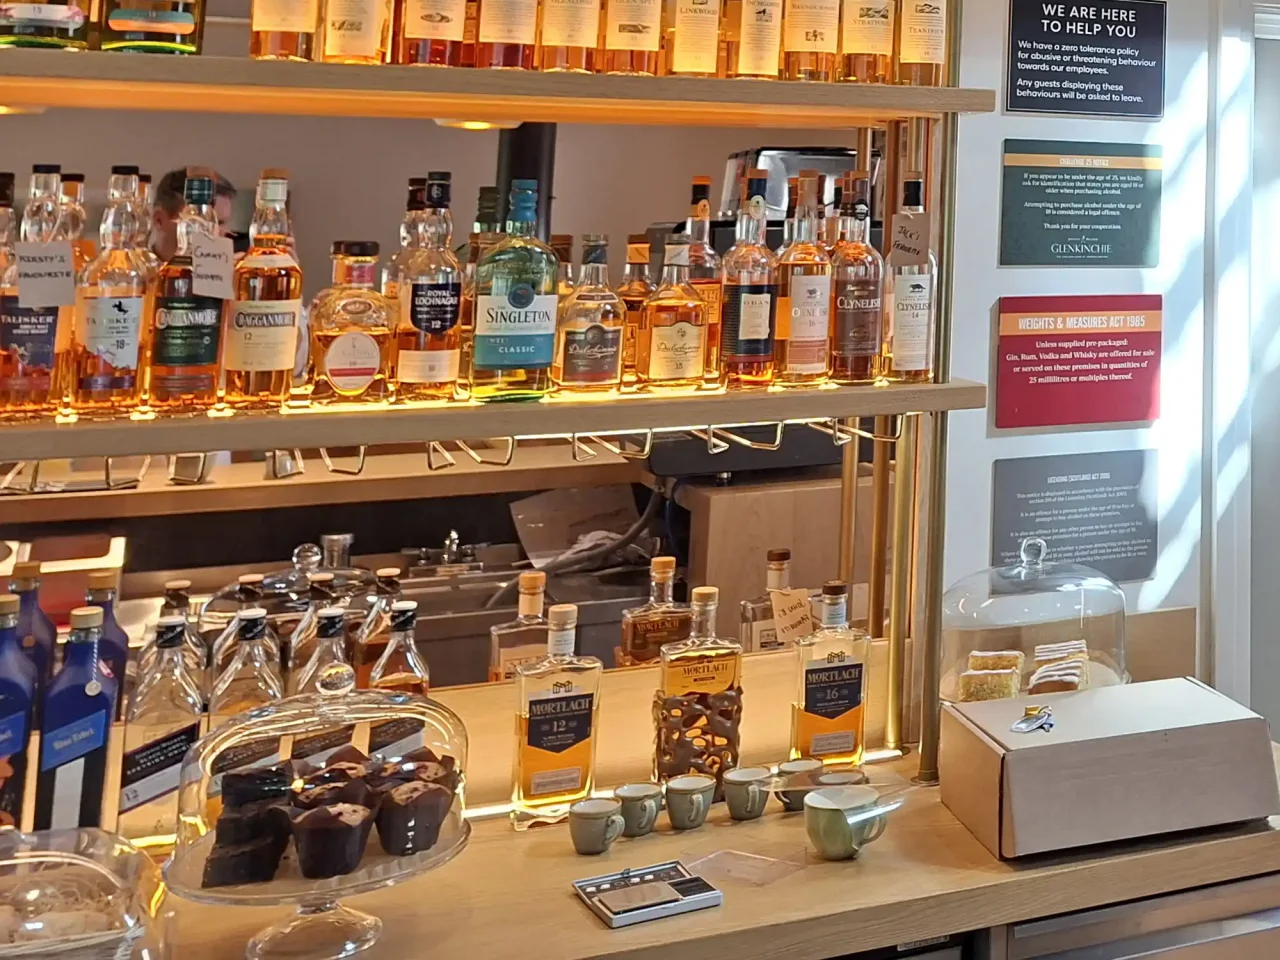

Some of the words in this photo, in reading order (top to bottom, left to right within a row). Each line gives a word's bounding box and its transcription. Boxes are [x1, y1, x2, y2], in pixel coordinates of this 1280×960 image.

[1042, 3, 1065, 17] WE
[1069, 6, 1097, 19] ARE
[1101, 8, 1136, 22] HERE
[1041, 19, 1061, 33] TO
[1066, 21, 1101, 35] HELP
[1106, 24, 1136, 38] YOU
[1018, 40, 1031, 49] We
[1033, 42, 1053, 50] have
[1061, 44, 1078, 52] zero
[1080, 45, 1115, 54] tolerance
[1117, 48, 1139, 57] policy
[1018, 51, 1029, 59] for
[1031, 52, 1061, 61] abusive
[1073, 55, 1117, 66] threatening
[1118, 57, 1156, 67] behaviour
[1017, 62, 1049, 71] towards
[1065, 66, 1109, 75] employees.
[1017, 78, 1032, 87] Any
[1034, 80, 1060, 88] guests
[1061, 81, 1101, 92] displaying
[1102, 83, 1124, 91] these
[1016, 89, 1060, 98] behaviours
[1062, 91, 1075, 99] will
[1088, 92, 1110, 101] asked
[1121, 94, 1144, 103] leave.
[1050, 243, 1112, 253] GLENKINCHIE
[415, 297, 458, 306] LOCHNAGAR
[0, 314, 55, 324] TALISKER
[486, 307, 551, 324] SINGLETON
[431, 320, 441, 329] 12
[1019, 317, 1054, 330] WEIGHTS
[1056, 317, 1063, 329] &
[1066, 316, 1107, 329] MEASURES
[1109, 315, 1124, 328] ACT
[1126, 315, 1145, 327] 1985
[1035, 340, 1057, 348] Unless
[1058, 340, 1085, 348] supplied
[1073, 351, 1097, 359] Whisky
[1072, 363, 1100, 371] premises
[1109, 361, 1140, 370] quantities
[1079, 374, 1108, 382] multiples
[636, 619, 680, 631] MORTLACH
[682, 663, 728, 676] MORTLACH
[807, 668, 861, 684] MORTLACH
[826, 688, 839, 700] 16
[530, 698, 591, 716] MORTLACH
[552, 720, 567, 732] 12
